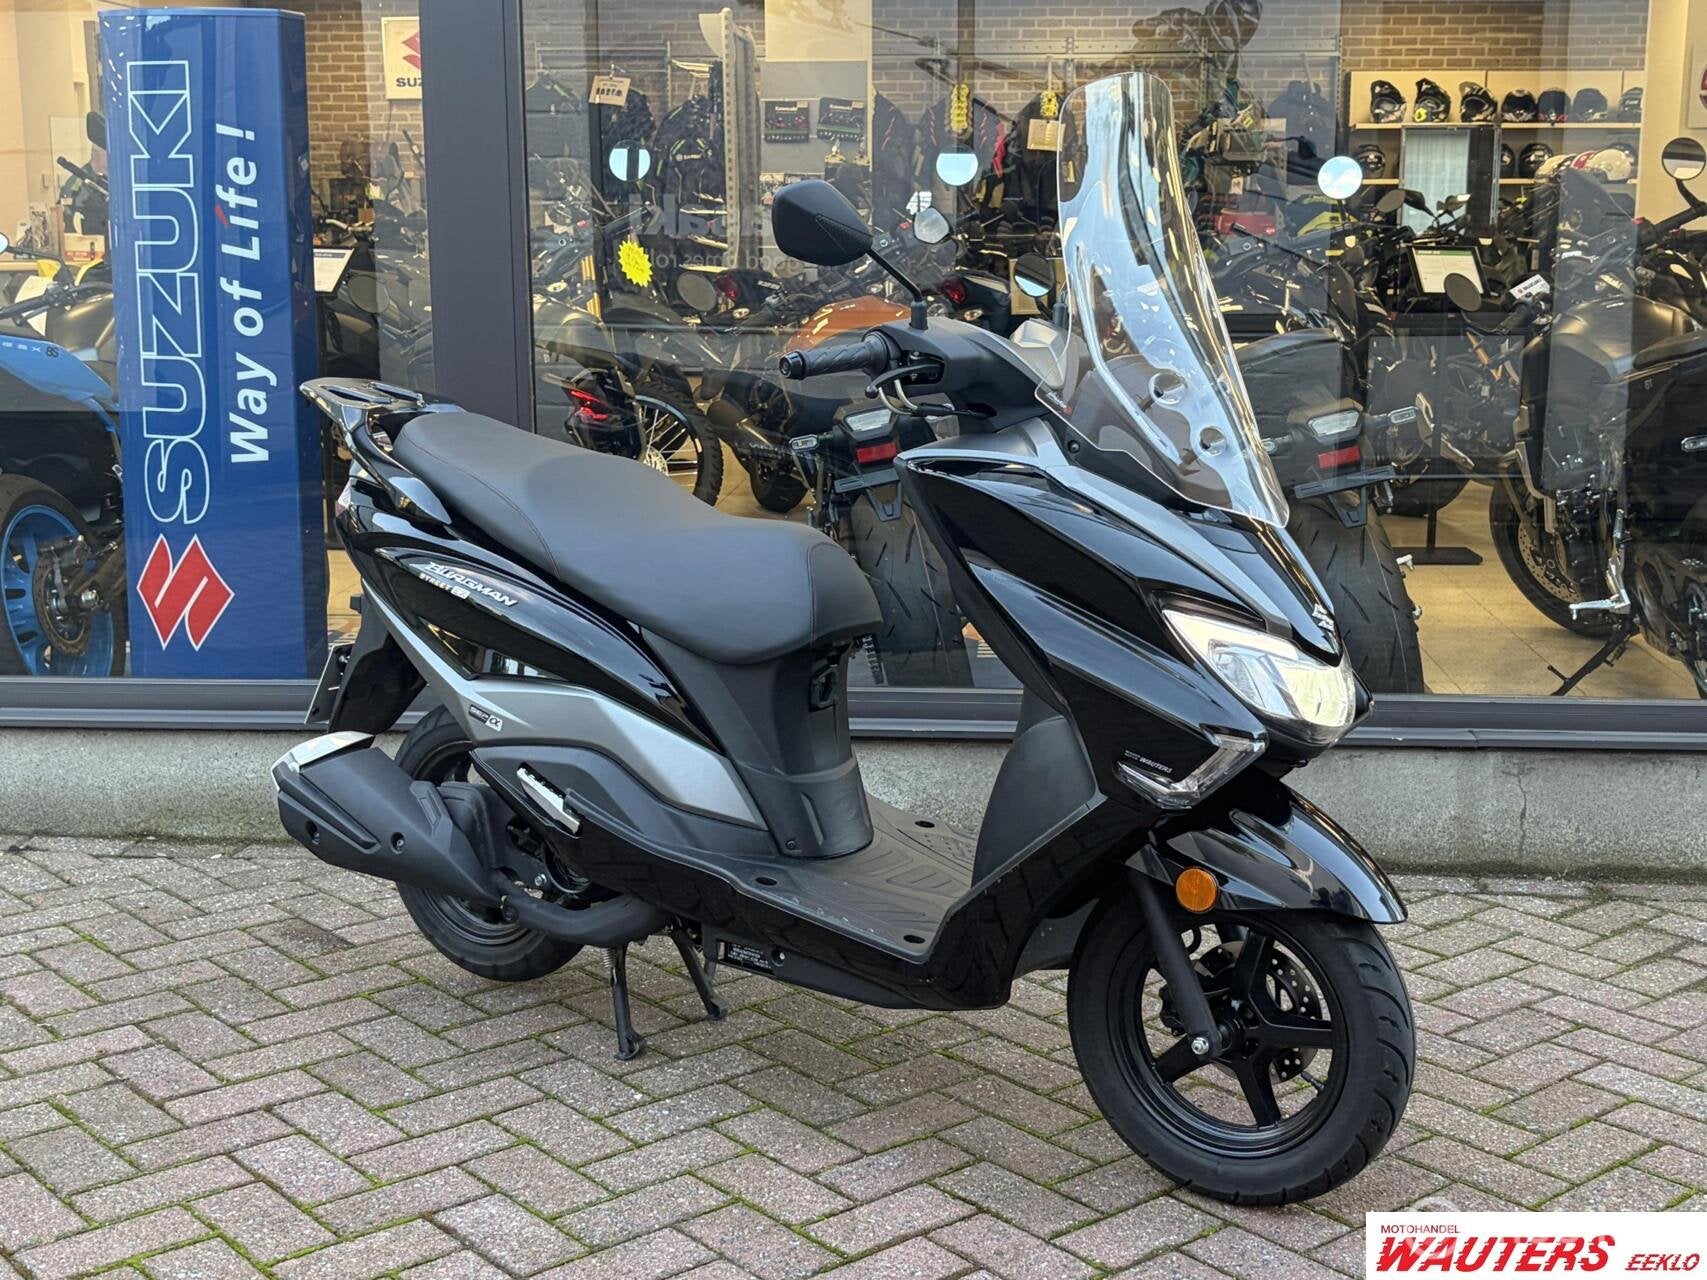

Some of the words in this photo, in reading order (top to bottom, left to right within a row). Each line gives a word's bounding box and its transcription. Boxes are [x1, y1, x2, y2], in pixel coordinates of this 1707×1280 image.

[127, 60, 210, 524] SUZUKI
[220, 276, 264, 337] of
[229, 352, 278, 463] Way
[425, 561, 518, 607] BURGMAN
